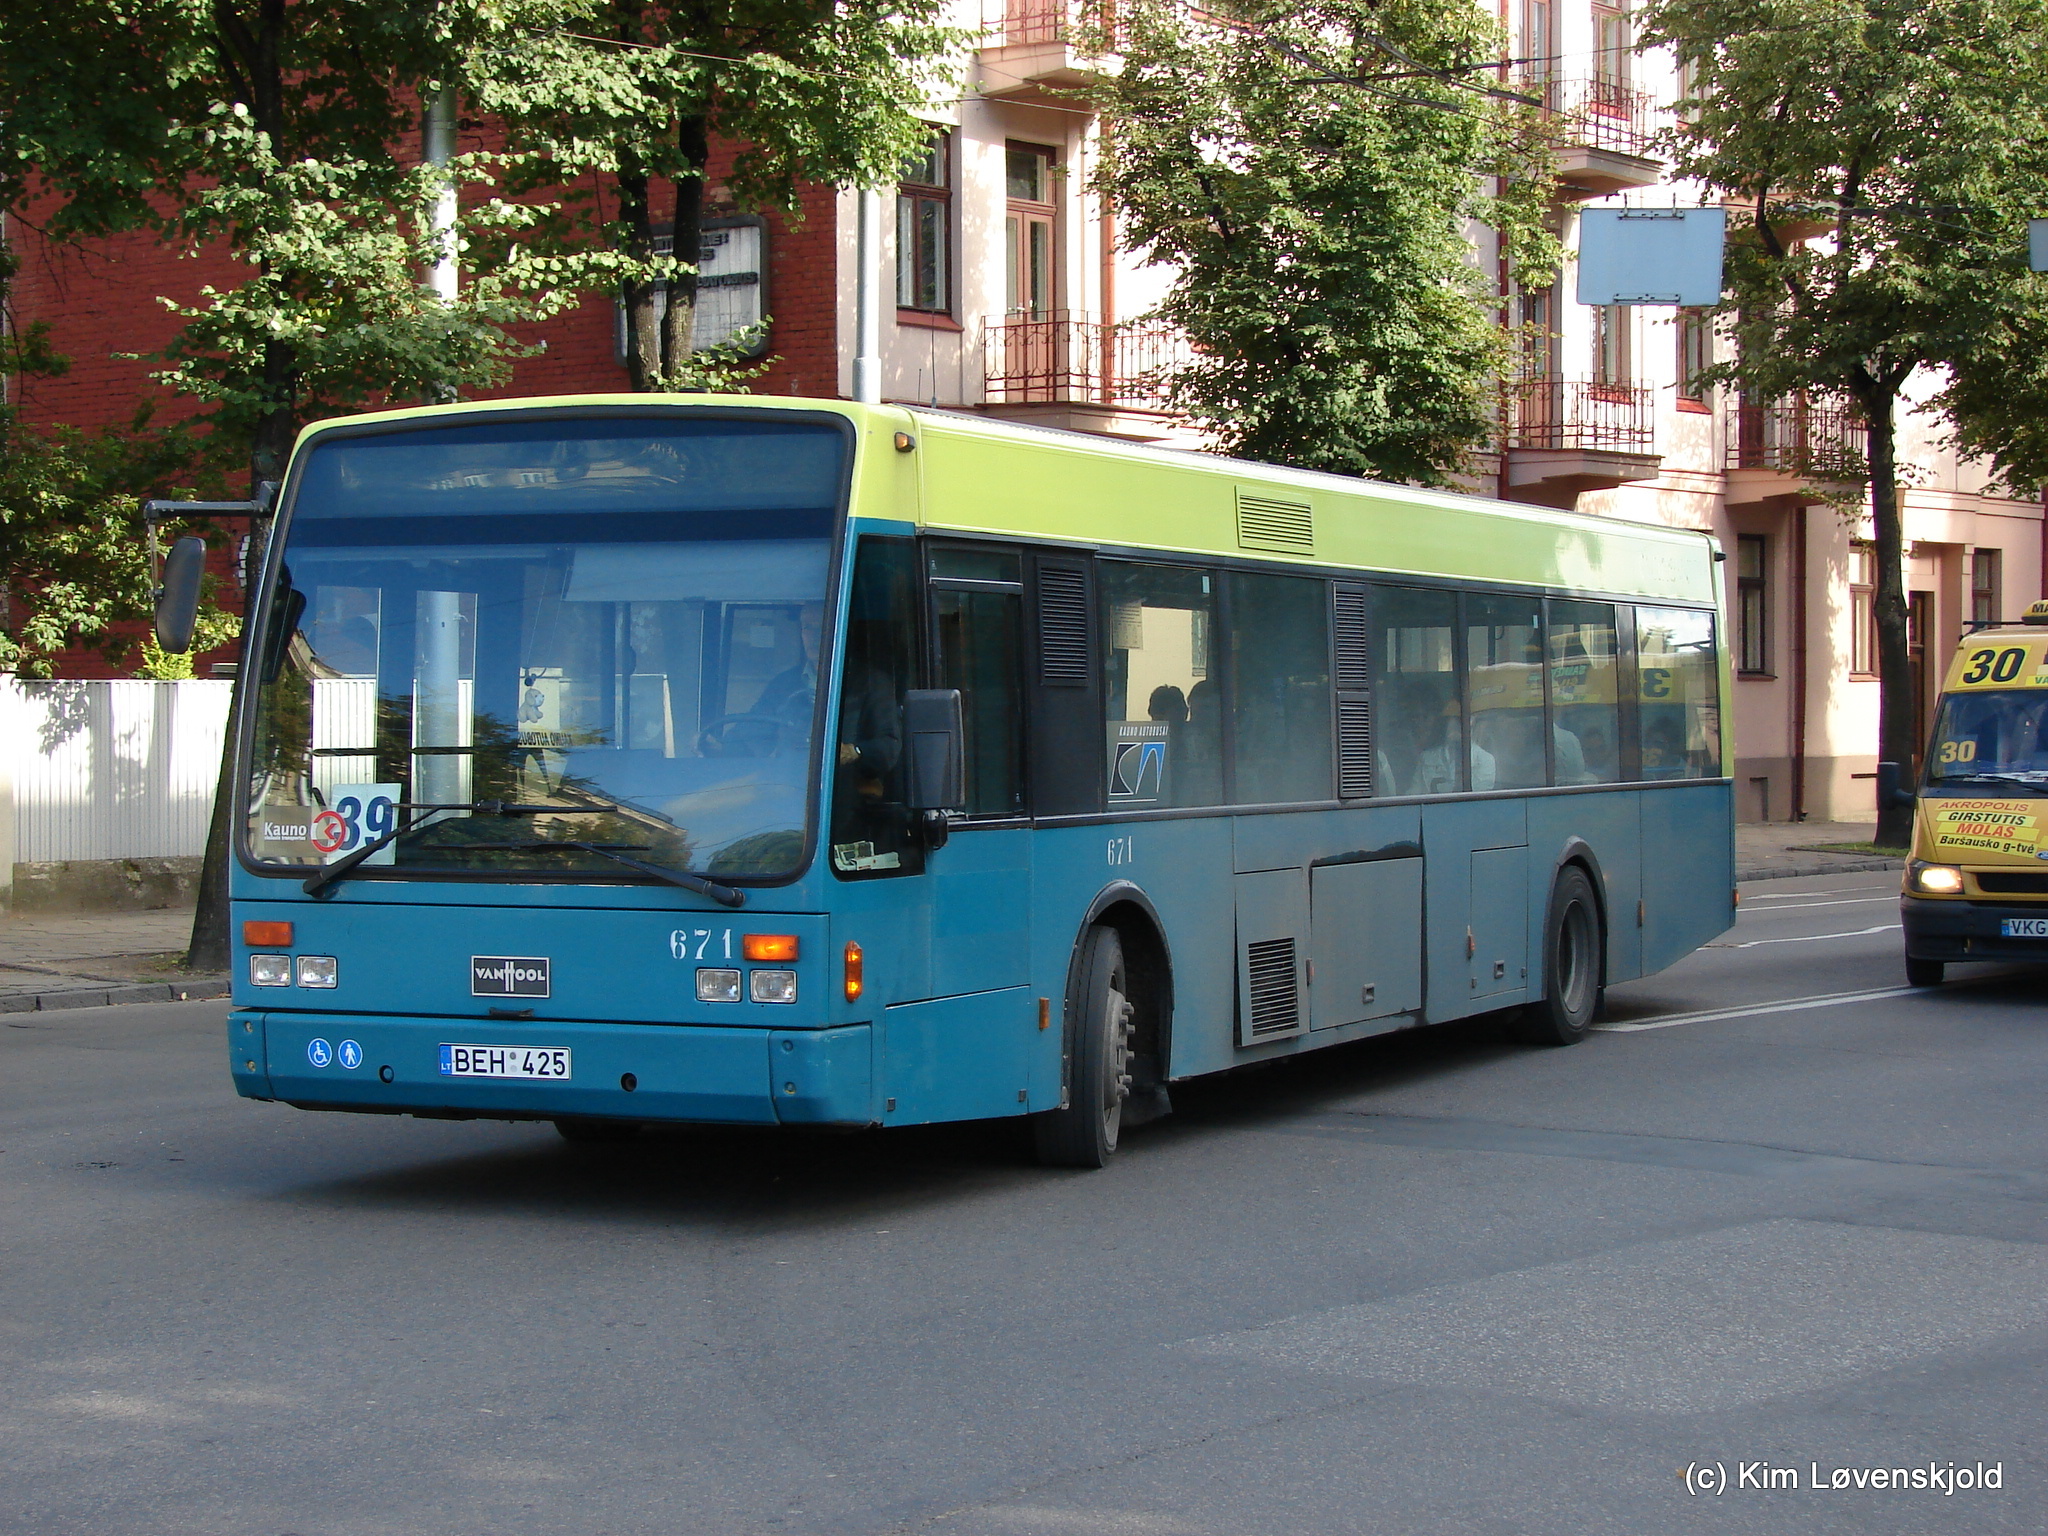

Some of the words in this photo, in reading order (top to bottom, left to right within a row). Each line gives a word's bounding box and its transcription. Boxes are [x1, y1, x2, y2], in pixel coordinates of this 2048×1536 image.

[1963, 648, 2023, 684] 30
[1940, 740, 1976, 763] 30
[1938, 801, 2029, 812] AKROPOLIS
[336, 796, 394, 851] 39
[1948, 812, 2026, 825] GIRSTUTIS
[264, 822, 307, 837] Kauno
[1956, 823, 2016, 838] MOLAS
[1939, 835, 2000, 849] Baršausko
[1107, 836, 1132, 865] 671
[2011, 920, 2046, 934] VKG
[670, 928, 732, 960] 671
[441, 1063, 452, 1071] LT
[455, 1049, 505, 1073] BEH
[522, 1051, 566, 1076] 425
